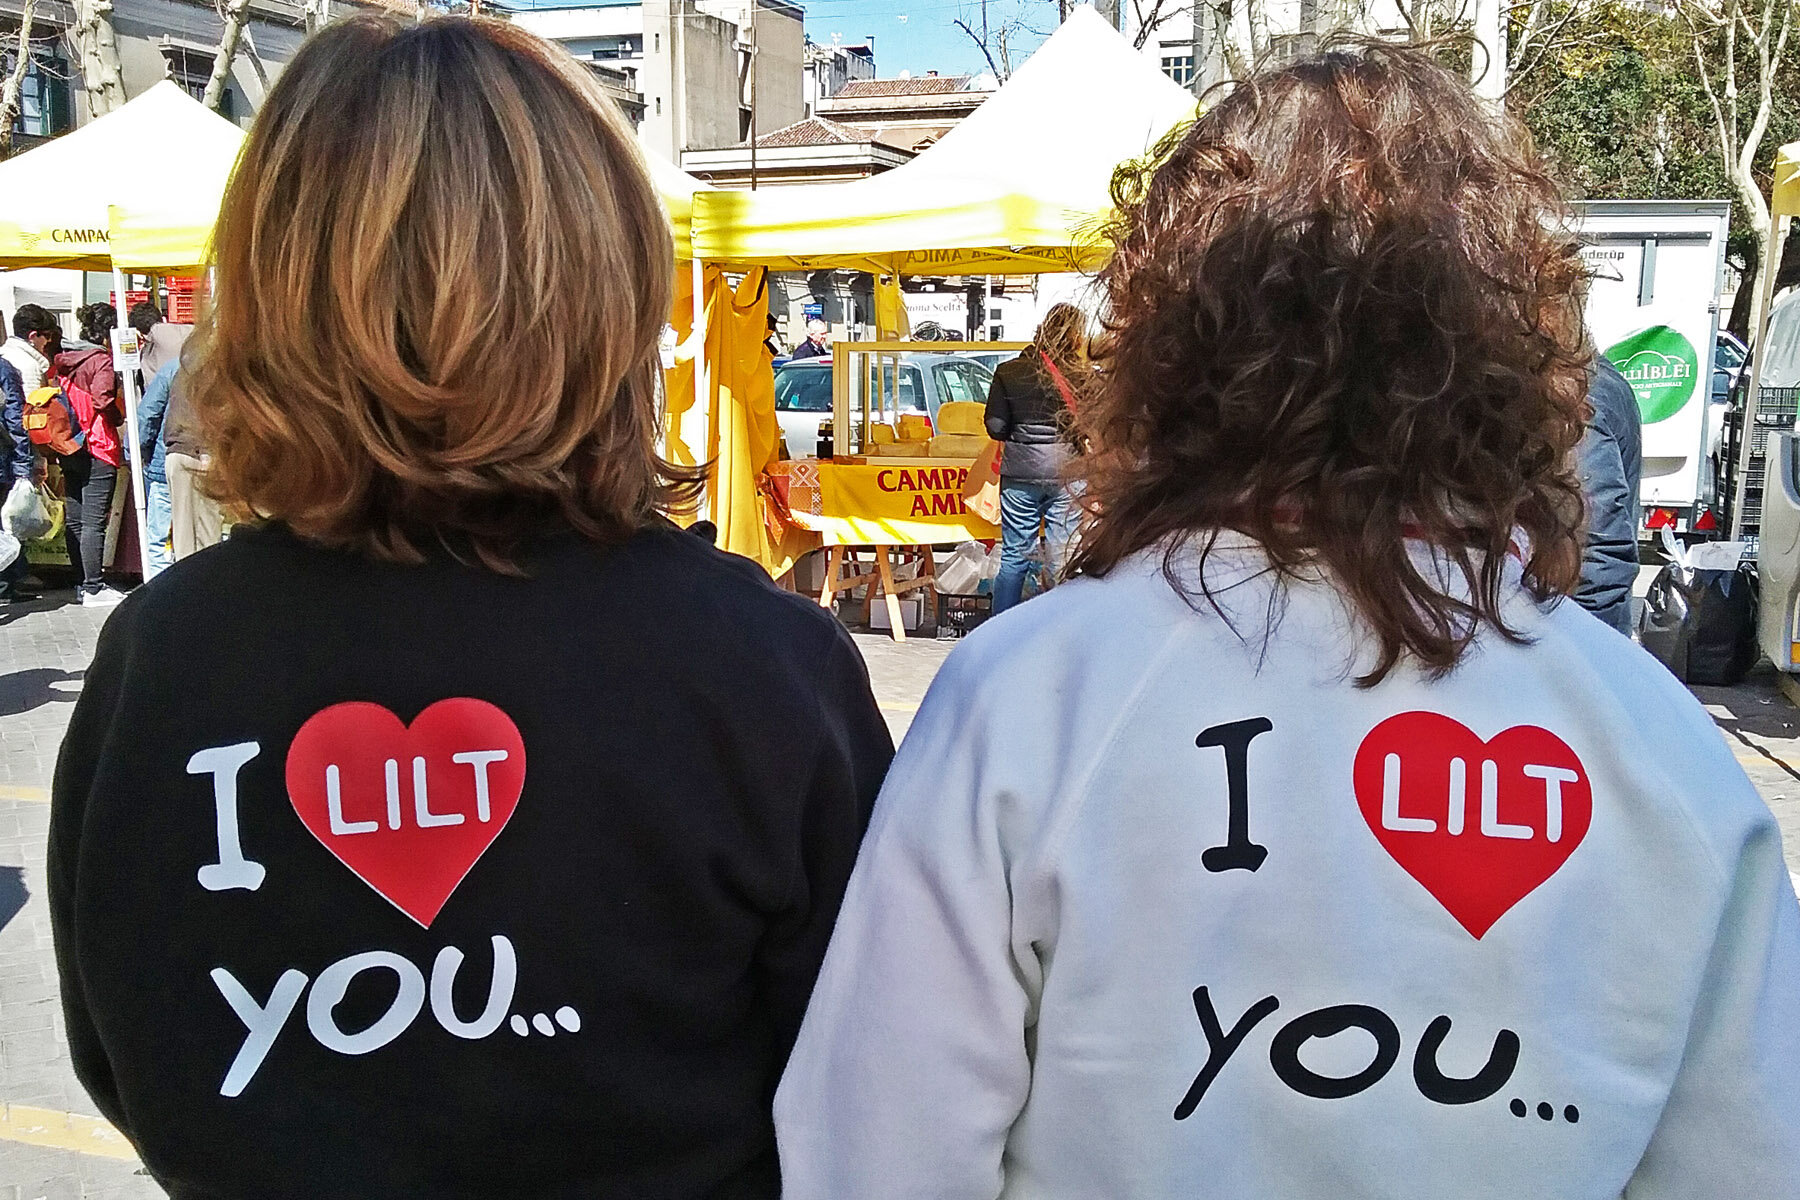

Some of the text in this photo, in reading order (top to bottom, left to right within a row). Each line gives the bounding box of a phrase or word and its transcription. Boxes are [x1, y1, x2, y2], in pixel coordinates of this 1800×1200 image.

[186, 740, 509, 892] I LILT
[1195, 716, 1579, 873] I LILT
